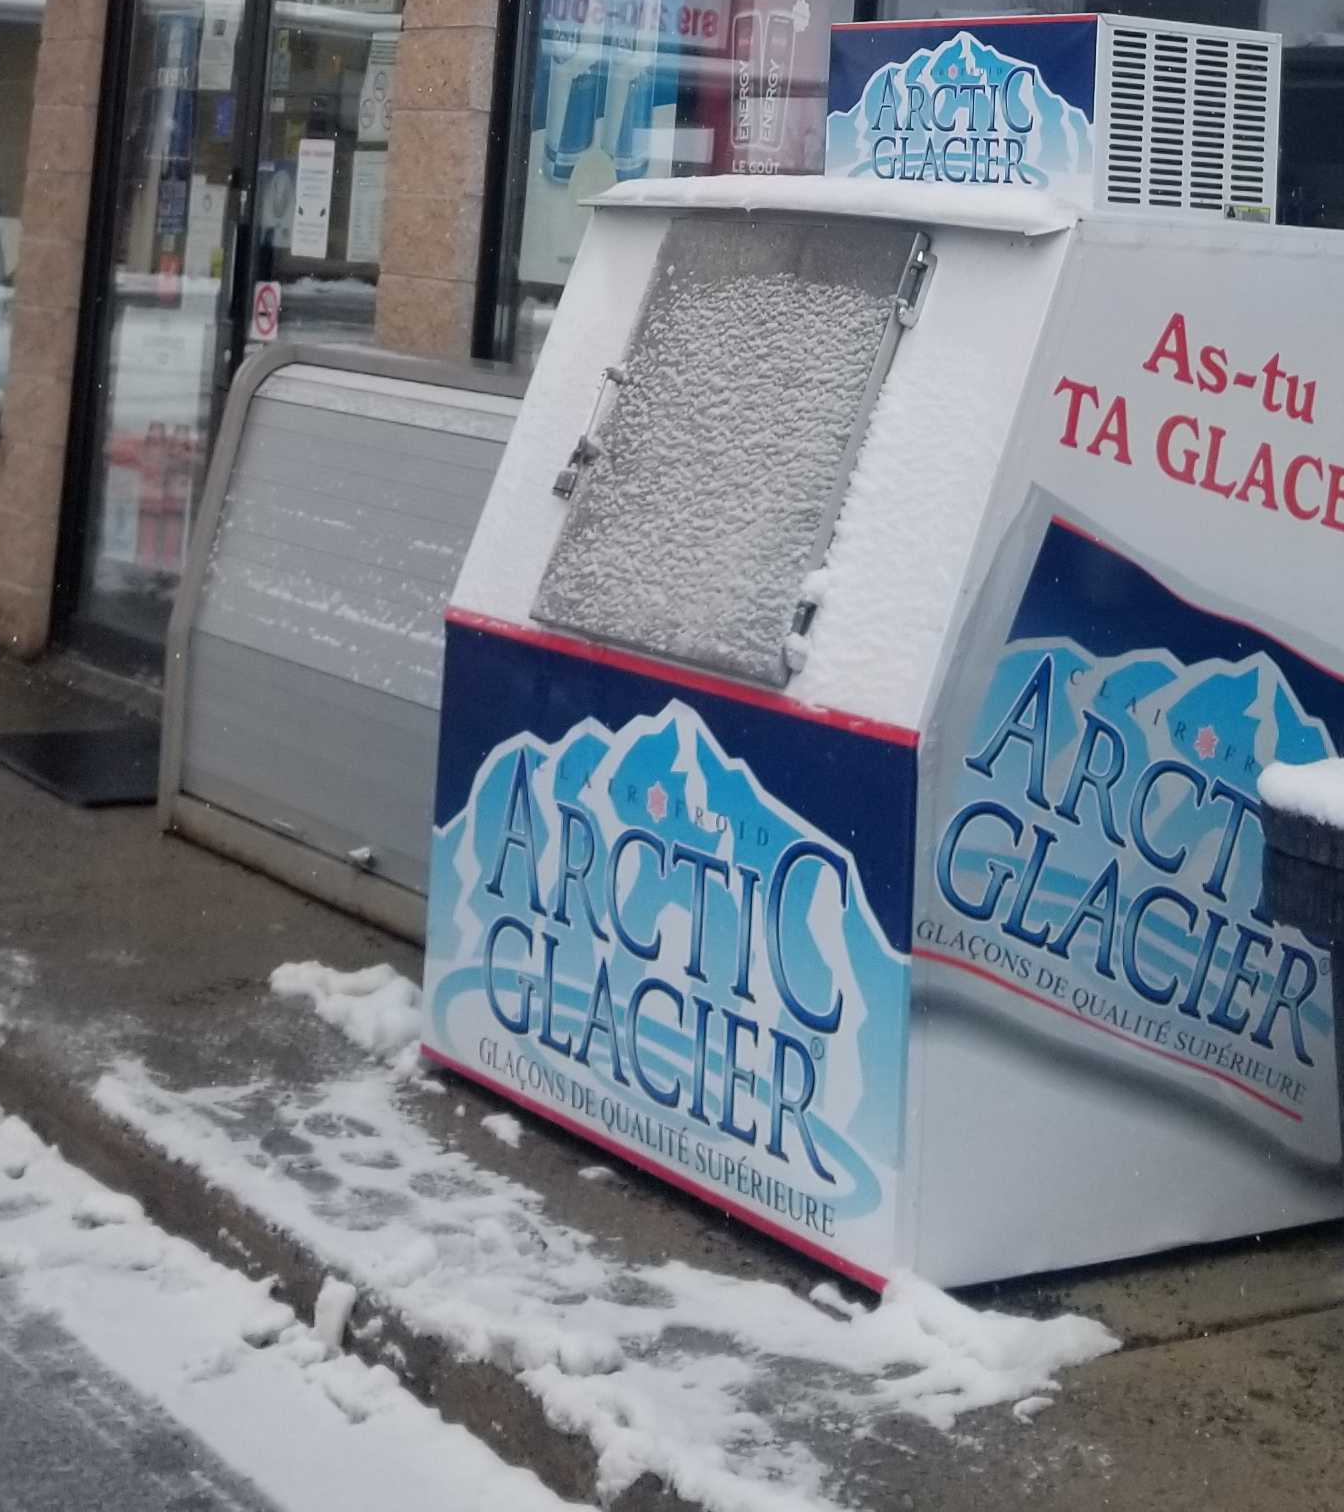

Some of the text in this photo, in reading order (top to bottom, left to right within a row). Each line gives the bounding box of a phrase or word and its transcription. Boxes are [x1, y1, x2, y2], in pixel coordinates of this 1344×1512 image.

[736, 60, 751, 145] ENERGY
[760, 58, 781, 142] ENERGY
[871, 66, 1036, 133] ARCTIC
[732, 160, 747, 173] LE
[872, 136, 1032, 185] GLACIER
[1142, 312, 1317, 424] As-tu
[1054, 375, 1133, 466] TA
[1070, 666, 1188, 742] CLAIR
[965, 653, 1296, 928] ARCT
[485, 745, 849, 1034] ARCTIC
[935, 800, 1319, 1068] GLACIER
[482, 914, 837, 1185] GLACIER
[917, 918, 1307, 1104] GLAÇONS DE QUALITÉ SUPÉRIEURE
[478, 1035, 838, 1238] GLAÇONS DE QUALITÉ SUPÉRIEURE
